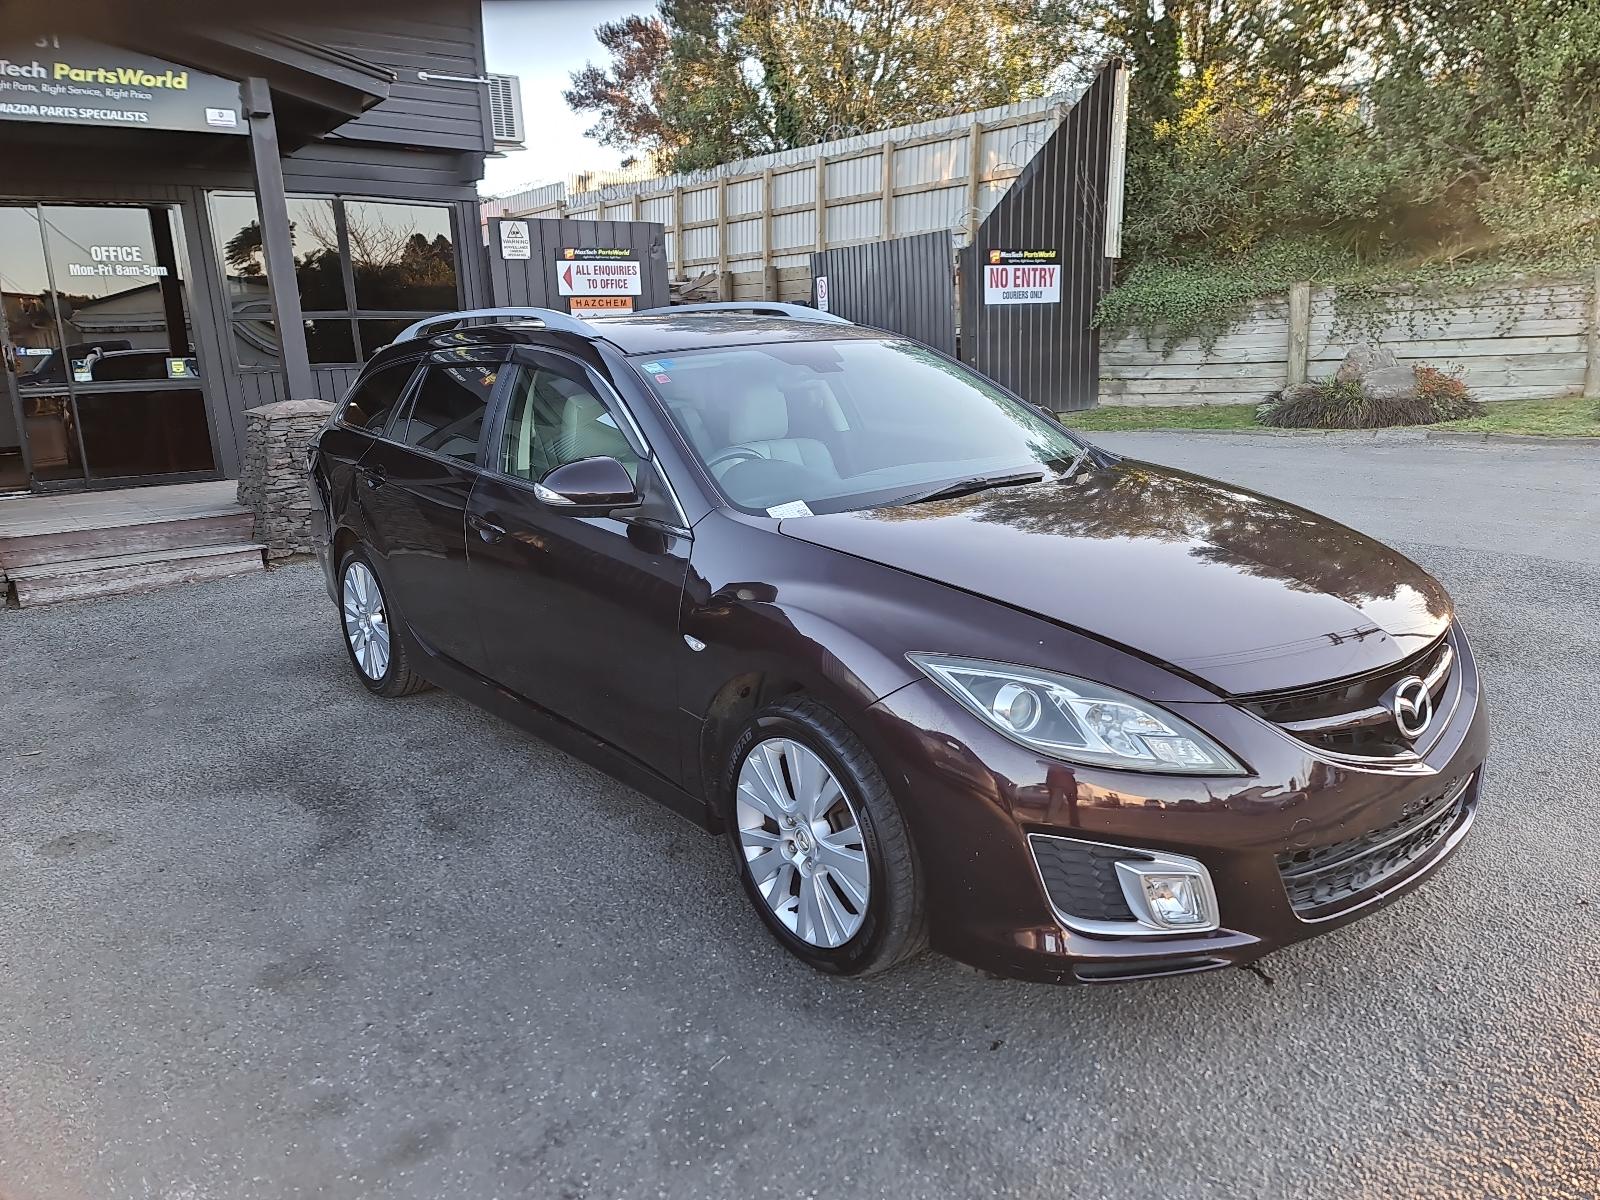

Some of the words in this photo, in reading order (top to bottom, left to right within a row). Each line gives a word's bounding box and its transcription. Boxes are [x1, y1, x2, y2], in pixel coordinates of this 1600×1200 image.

[53, 62, 189, 90] PartsWorld
[41, 83, 67, 96] Right
[105, 88, 129, 100] Right
[39, 105, 78, 118] PARTS
[78, 108, 150, 122] SPECIALISTS
[90, 245, 143, 262] OFFICE
[598, 248, 631, 256] PartsWorld
[69, 263, 113, 277] Mon-Fri
[115, 264, 169, 277] 8am-5pm
[575, 264, 592, 276] ALL
[594, 265, 638, 276] ENQUIRIES
[586, 278, 598, 289] TO
[600, 278, 629, 289] OFFICE
[989, 267, 1009, 289] NO
[1013, 267, 1056, 288] ENTRY
[1002, 290, 1029, 300] COURIERS
[1030, 290, 1043, 299] ONLY
[575, 299, 628, 307] HAZCHEM
